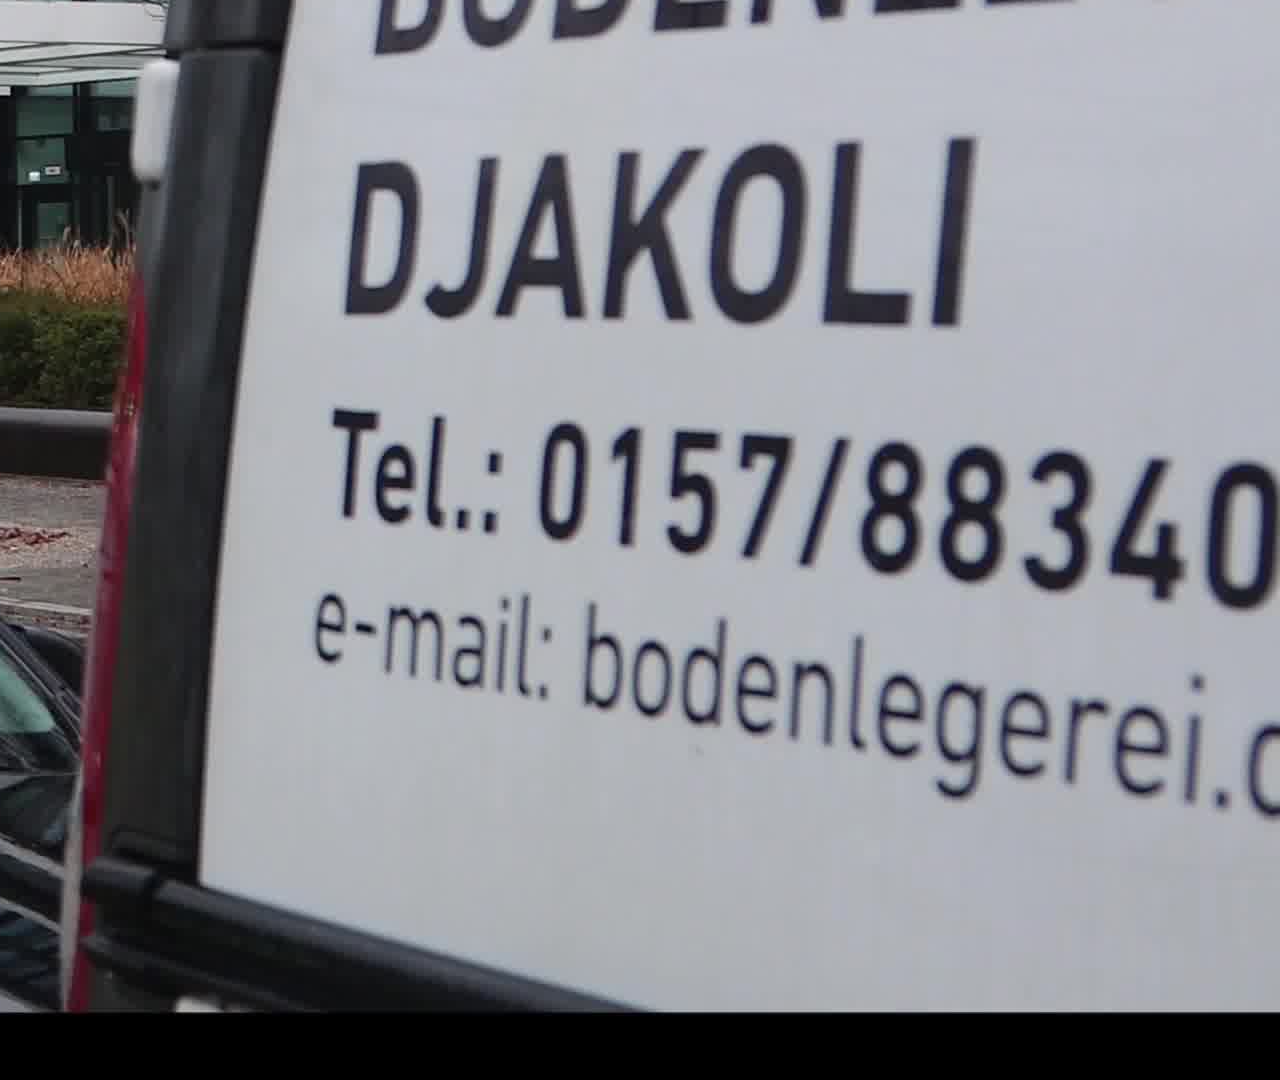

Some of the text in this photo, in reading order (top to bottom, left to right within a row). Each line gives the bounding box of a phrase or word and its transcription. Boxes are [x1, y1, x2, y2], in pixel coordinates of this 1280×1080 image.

[343, 136, 975, 328] DJAKOLI
[332, 407, 1280, 611] Tel.: 0157/88340
[314, 593, 554, 702] e-mail:
